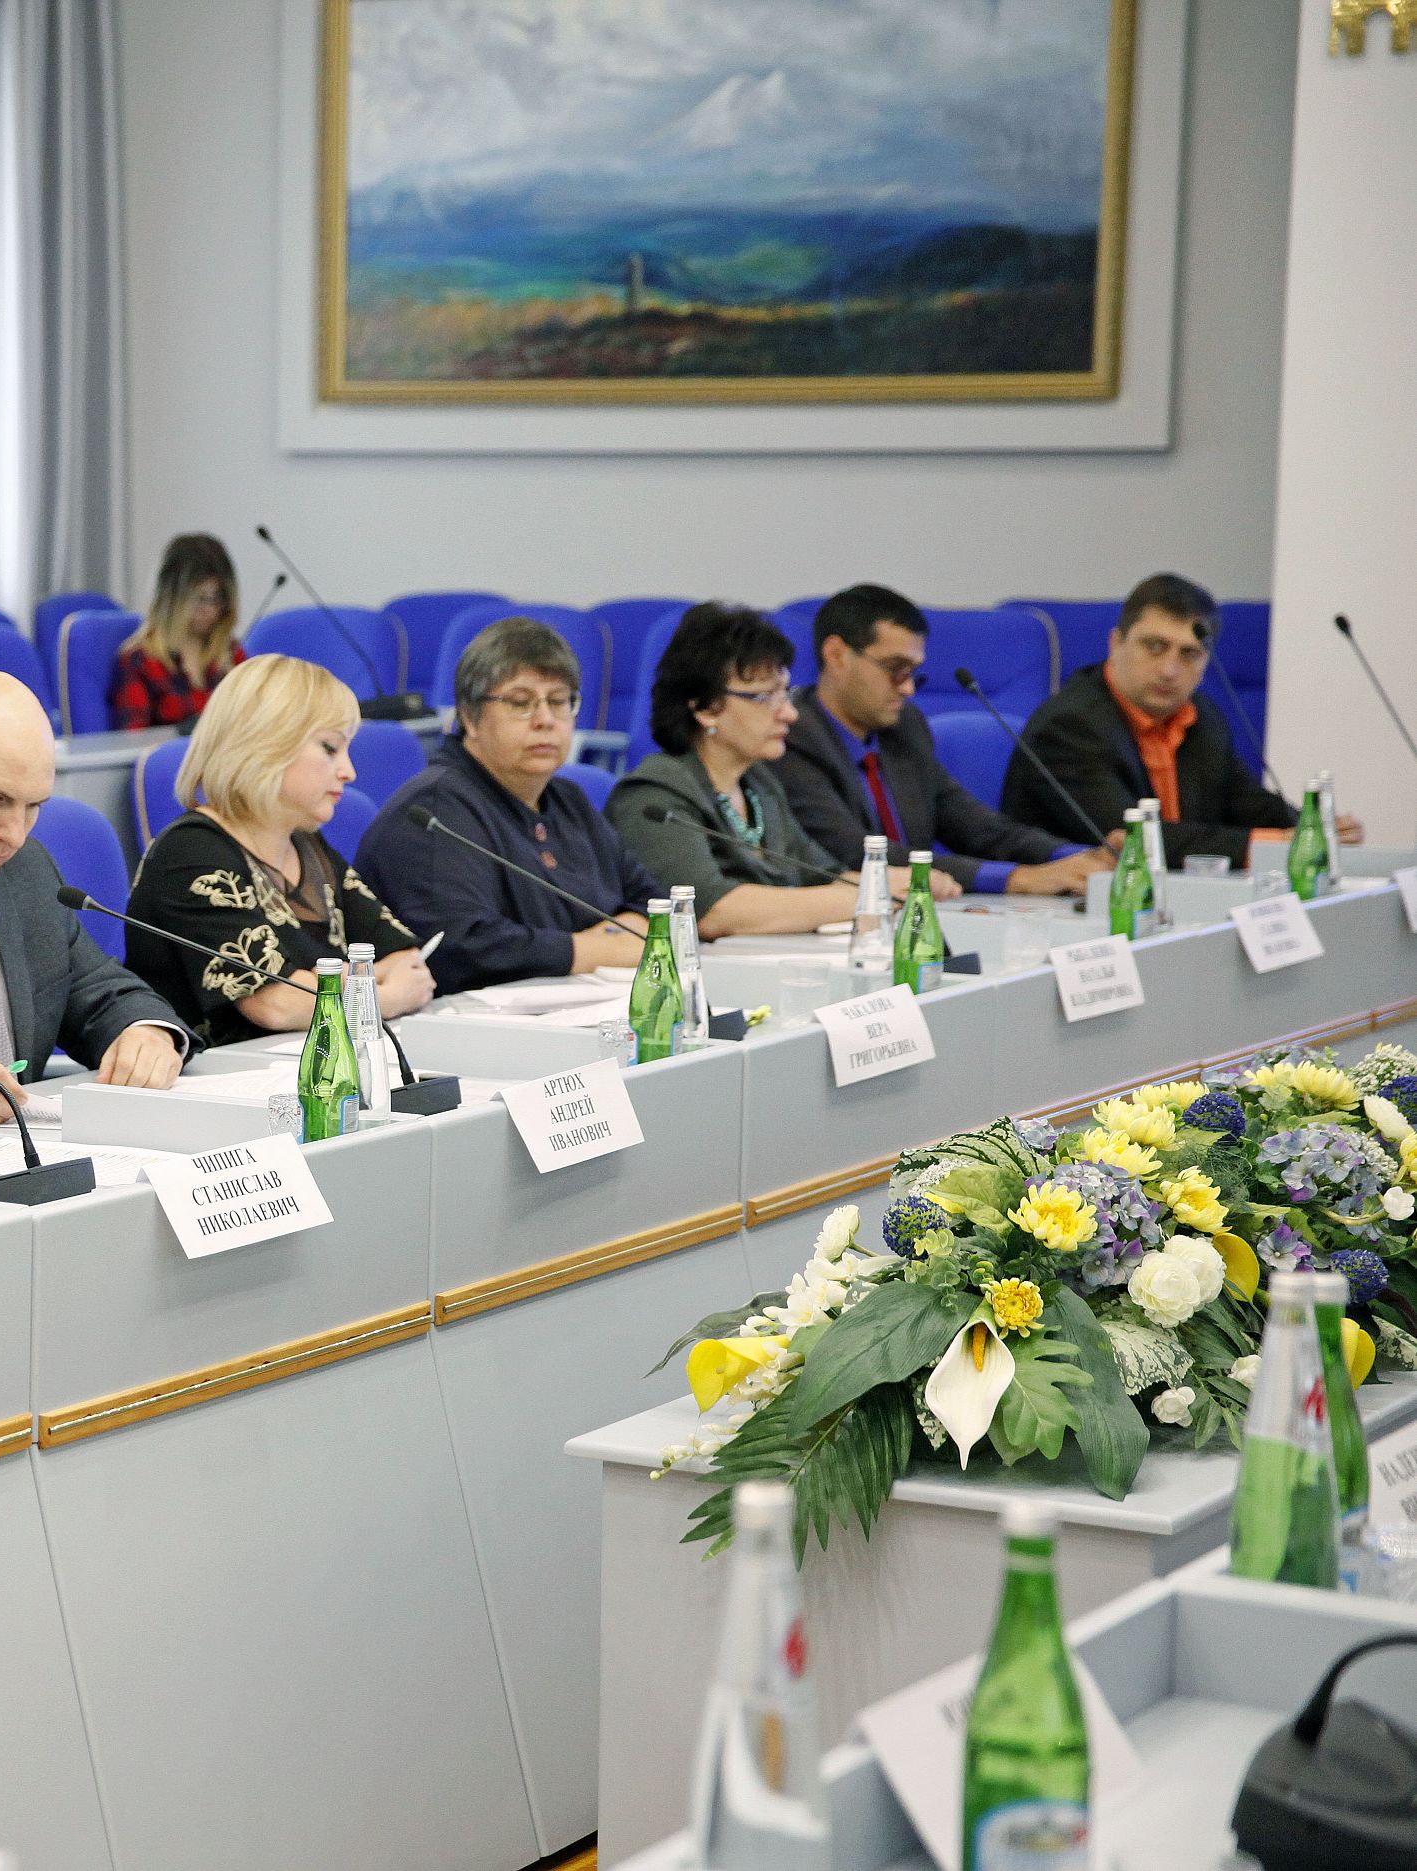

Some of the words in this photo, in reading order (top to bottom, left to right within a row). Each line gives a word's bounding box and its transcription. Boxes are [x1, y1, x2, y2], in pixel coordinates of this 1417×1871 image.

[864, 1022, 892, 1039] ВЕРА
[849, 1039, 918, 1069] ГРИГОРЬЕВНА
[543, 1073, 585, 1098] АРТЮХ
[550, 1094, 595, 1125] АНДРЕЙ
[549, 1121, 612, 1152] ИВАНОВИЧ
[192, 1147, 257, 1174] ЧИПИГА
[192, 1171, 282, 1206] СТАНИСЛАВ
[196, 1196, 300, 1236] НИКОЛАЕВИЧ
